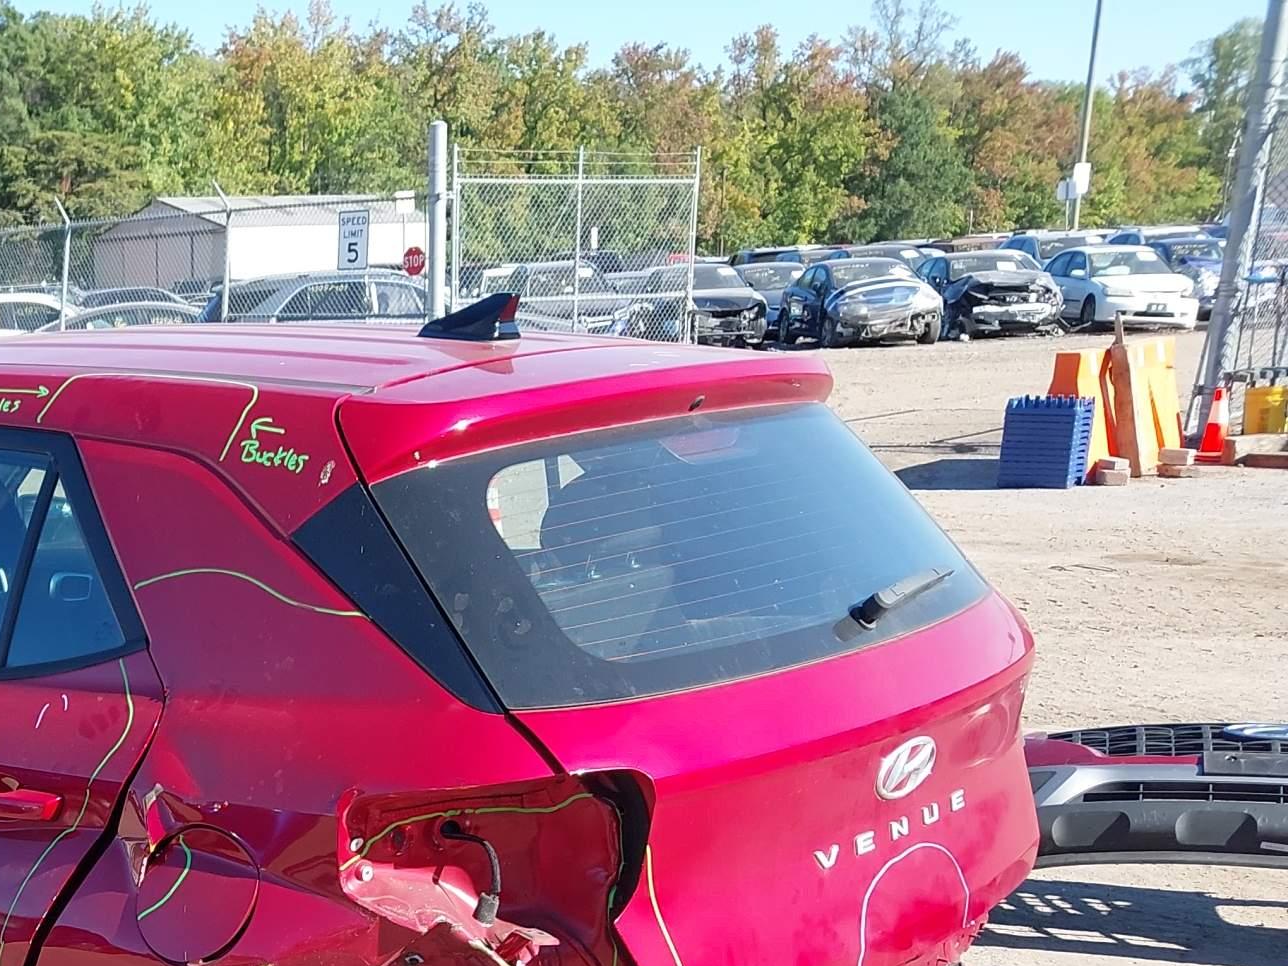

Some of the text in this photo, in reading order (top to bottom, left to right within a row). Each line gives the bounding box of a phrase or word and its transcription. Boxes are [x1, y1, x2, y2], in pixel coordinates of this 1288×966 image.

[341, 216, 367, 226] SPEED
[343, 229, 364, 239] LIMIT
[347, 242, 359, 263] 5
[404, 254, 425, 269] STOP
[240, 440, 309, 474] Buckles
[813, 789, 966, 870] VENUE
